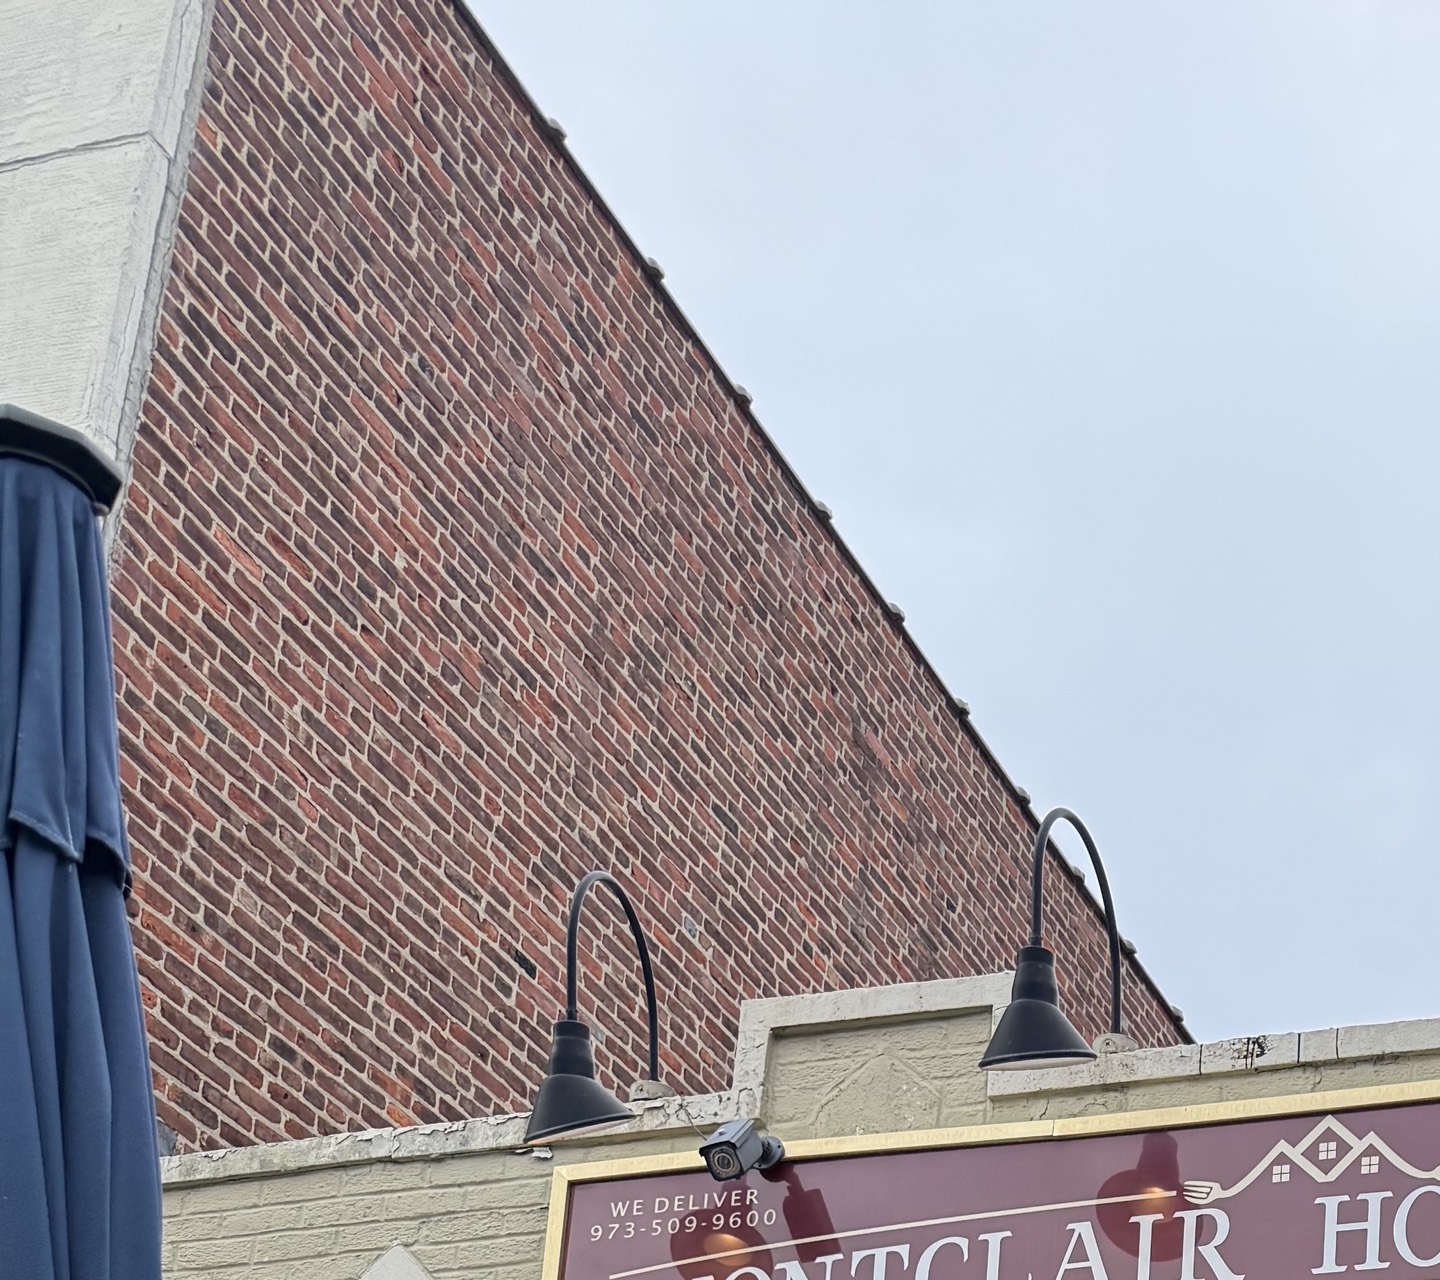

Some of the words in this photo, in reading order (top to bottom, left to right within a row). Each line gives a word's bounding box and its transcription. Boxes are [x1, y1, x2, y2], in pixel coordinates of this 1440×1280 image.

[609, 1196, 645, 1218] WE
[653, 1188, 760, 1215] DELIVER
[589, 1207, 777, 1243] 973-509-9600
